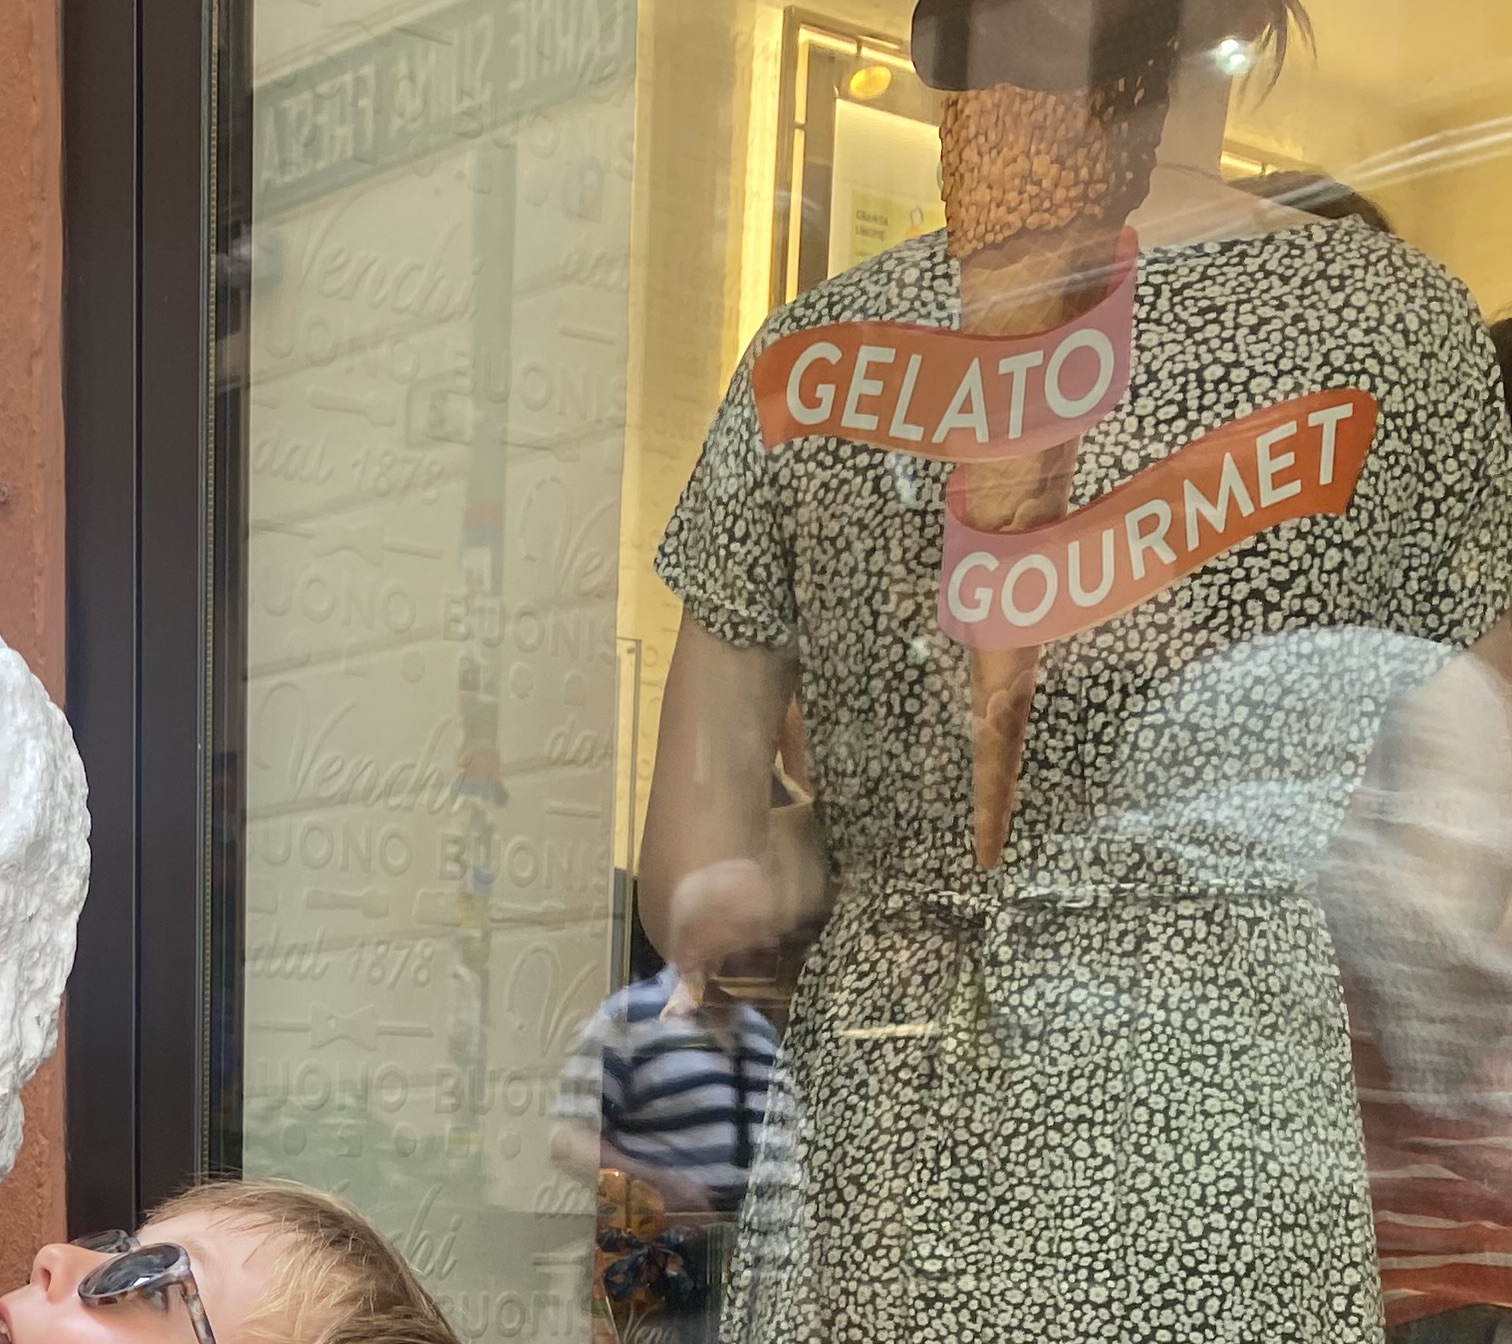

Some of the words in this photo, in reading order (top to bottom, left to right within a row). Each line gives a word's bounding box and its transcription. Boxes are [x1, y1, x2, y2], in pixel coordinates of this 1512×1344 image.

[786, 328, 1115, 445] GELATO
[947, 402, 1355, 628] GOURMET
[262, 561, 418, 635] UONO
[442, 585, 617, 665] BUONIS
[260, 821, 413, 877] UONO
[436, 833, 612, 892] BUONIS
[256, 1057, 409, 1115] UONO
